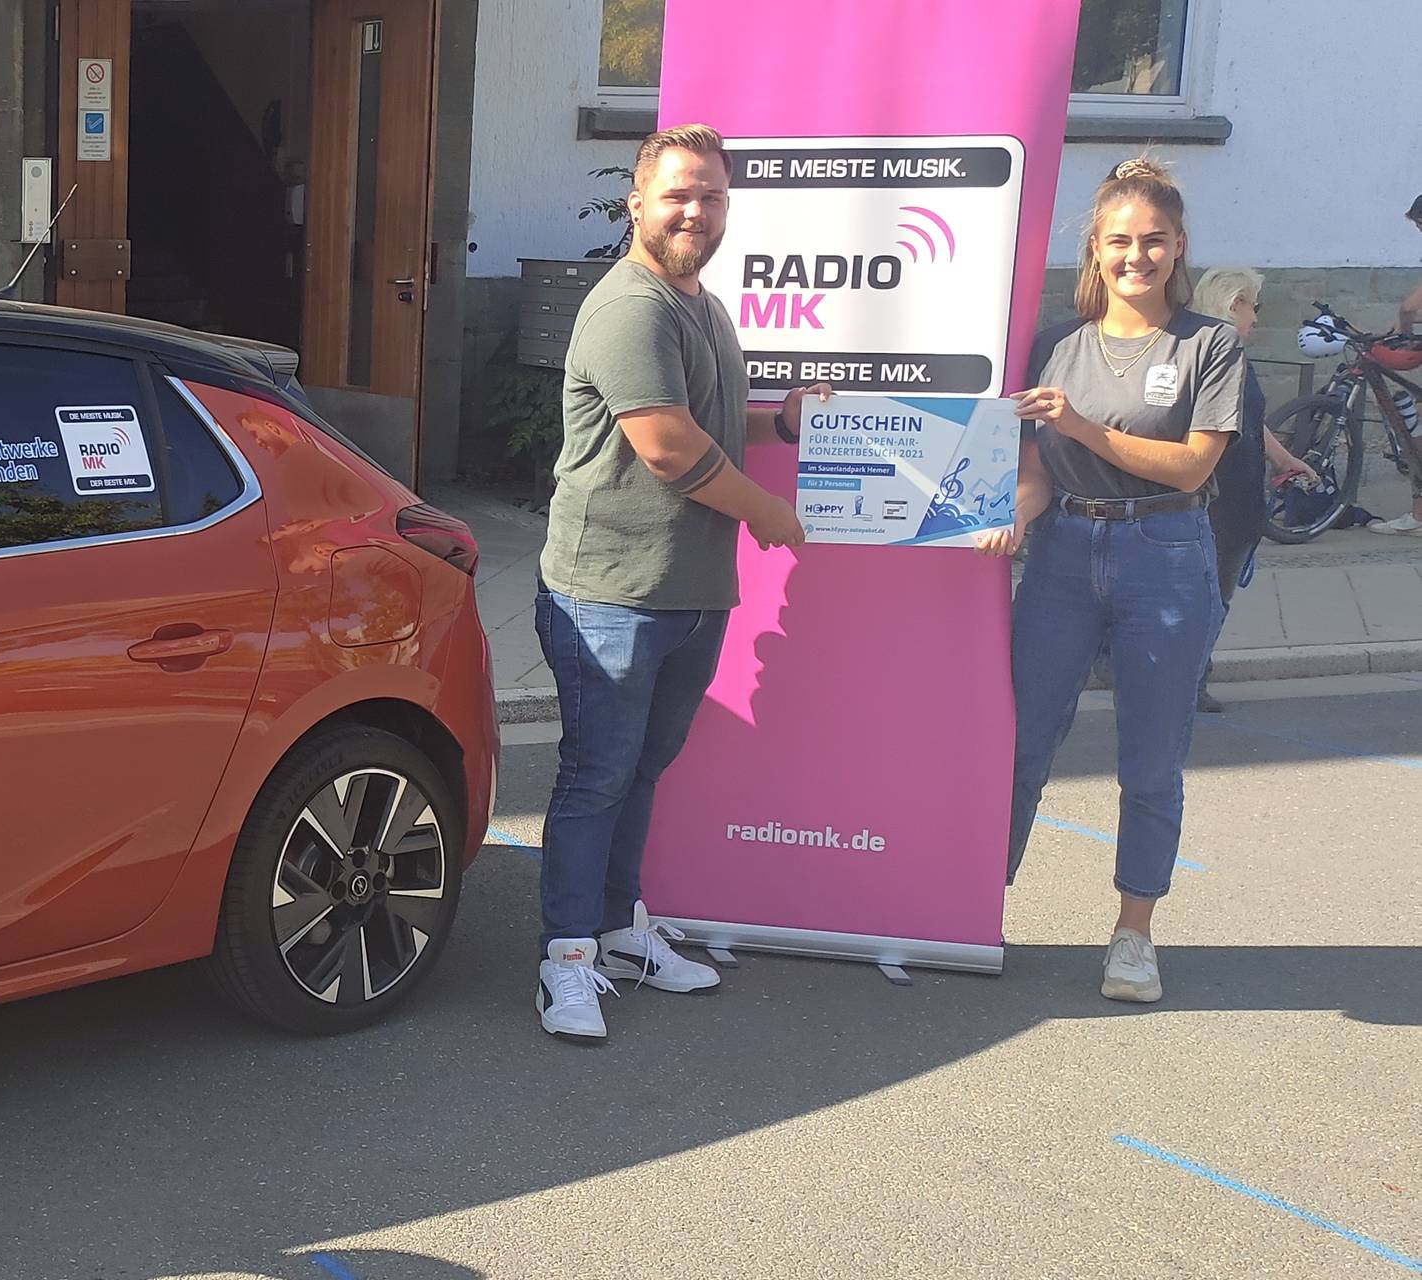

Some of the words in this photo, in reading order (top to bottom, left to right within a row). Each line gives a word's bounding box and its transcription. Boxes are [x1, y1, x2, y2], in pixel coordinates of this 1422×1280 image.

[746, 159, 783, 179] DIE
[789, 158, 876, 178] MEISTE
[882, 157, 966, 178] MUSIK.
[742, 254, 902, 290] RADIO
[739, 293, 827, 329] MK
[746, 360, 793, 380] DER
[800, 362, 873, 381] BESTE
[880, 363, 932, 383] MIX.
[80, 412, 102, 420] MEISTE
[810, 414, 923, 432] GUTSCHEIN
[809, 433, 829, 444] FÜR
[832, 435, 863, 445] EINEN
[865, 436, 919, 447] OPEN-AIR-
[79, 443, 121, 456] RADIO
[808, 446, 896, 458] KONZERTBESUCH
[899, 449, 924, 458] 2021
[82, 456, 106, 470] MK
[818, 465, 866, 474] Sauerlandpark
[867, 466, 890, 474] Hemer
[90, 479, 103, 487] DER
[726, 821, 886, 851] radiomk.de
